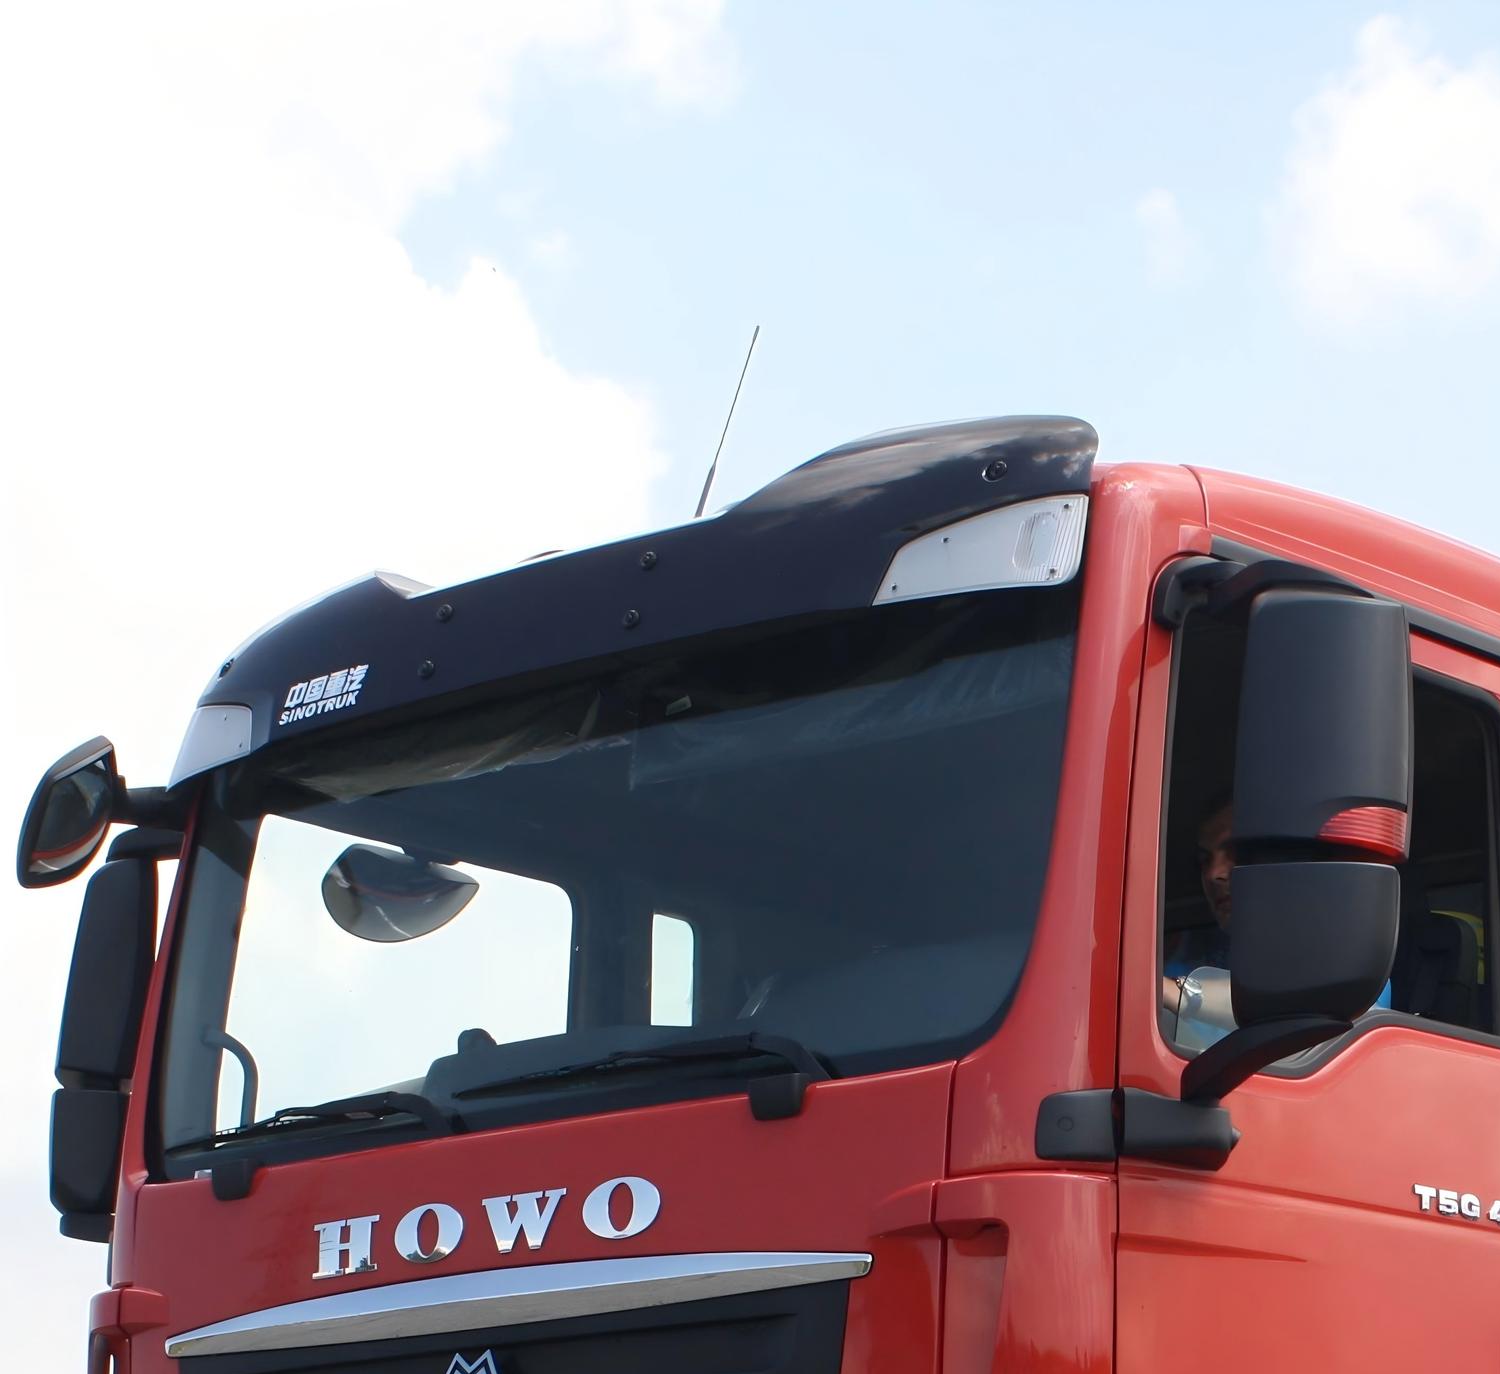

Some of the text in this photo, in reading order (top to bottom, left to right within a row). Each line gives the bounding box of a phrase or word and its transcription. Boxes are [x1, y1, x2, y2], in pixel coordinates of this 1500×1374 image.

[279, 690, 360, 726] SINOTRUK
[1413, 1183, 1481, 1221] T5G
[312, 1176, 661, 1280] HOWO
